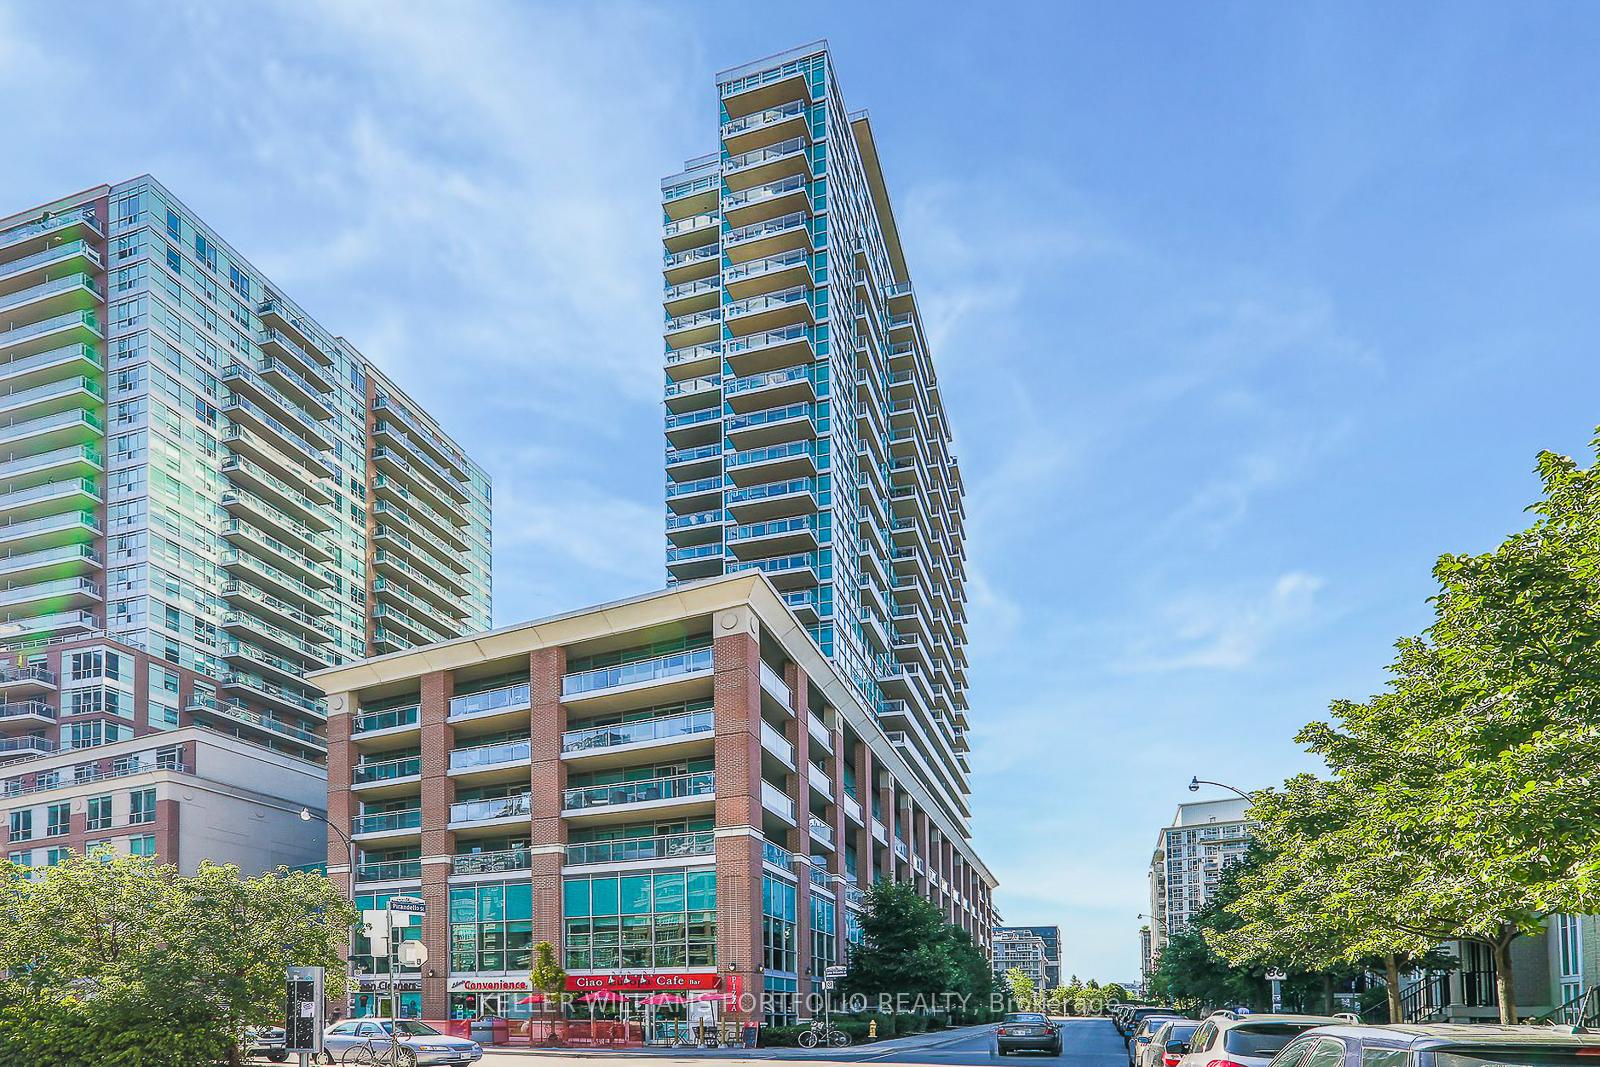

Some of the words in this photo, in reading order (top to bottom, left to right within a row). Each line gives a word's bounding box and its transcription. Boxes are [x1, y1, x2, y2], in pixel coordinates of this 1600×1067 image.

[464, 980, 526, 990] Convenience
[576, 977, 603, 987] Ciao
[656, 975, 684, 985] Cafe
